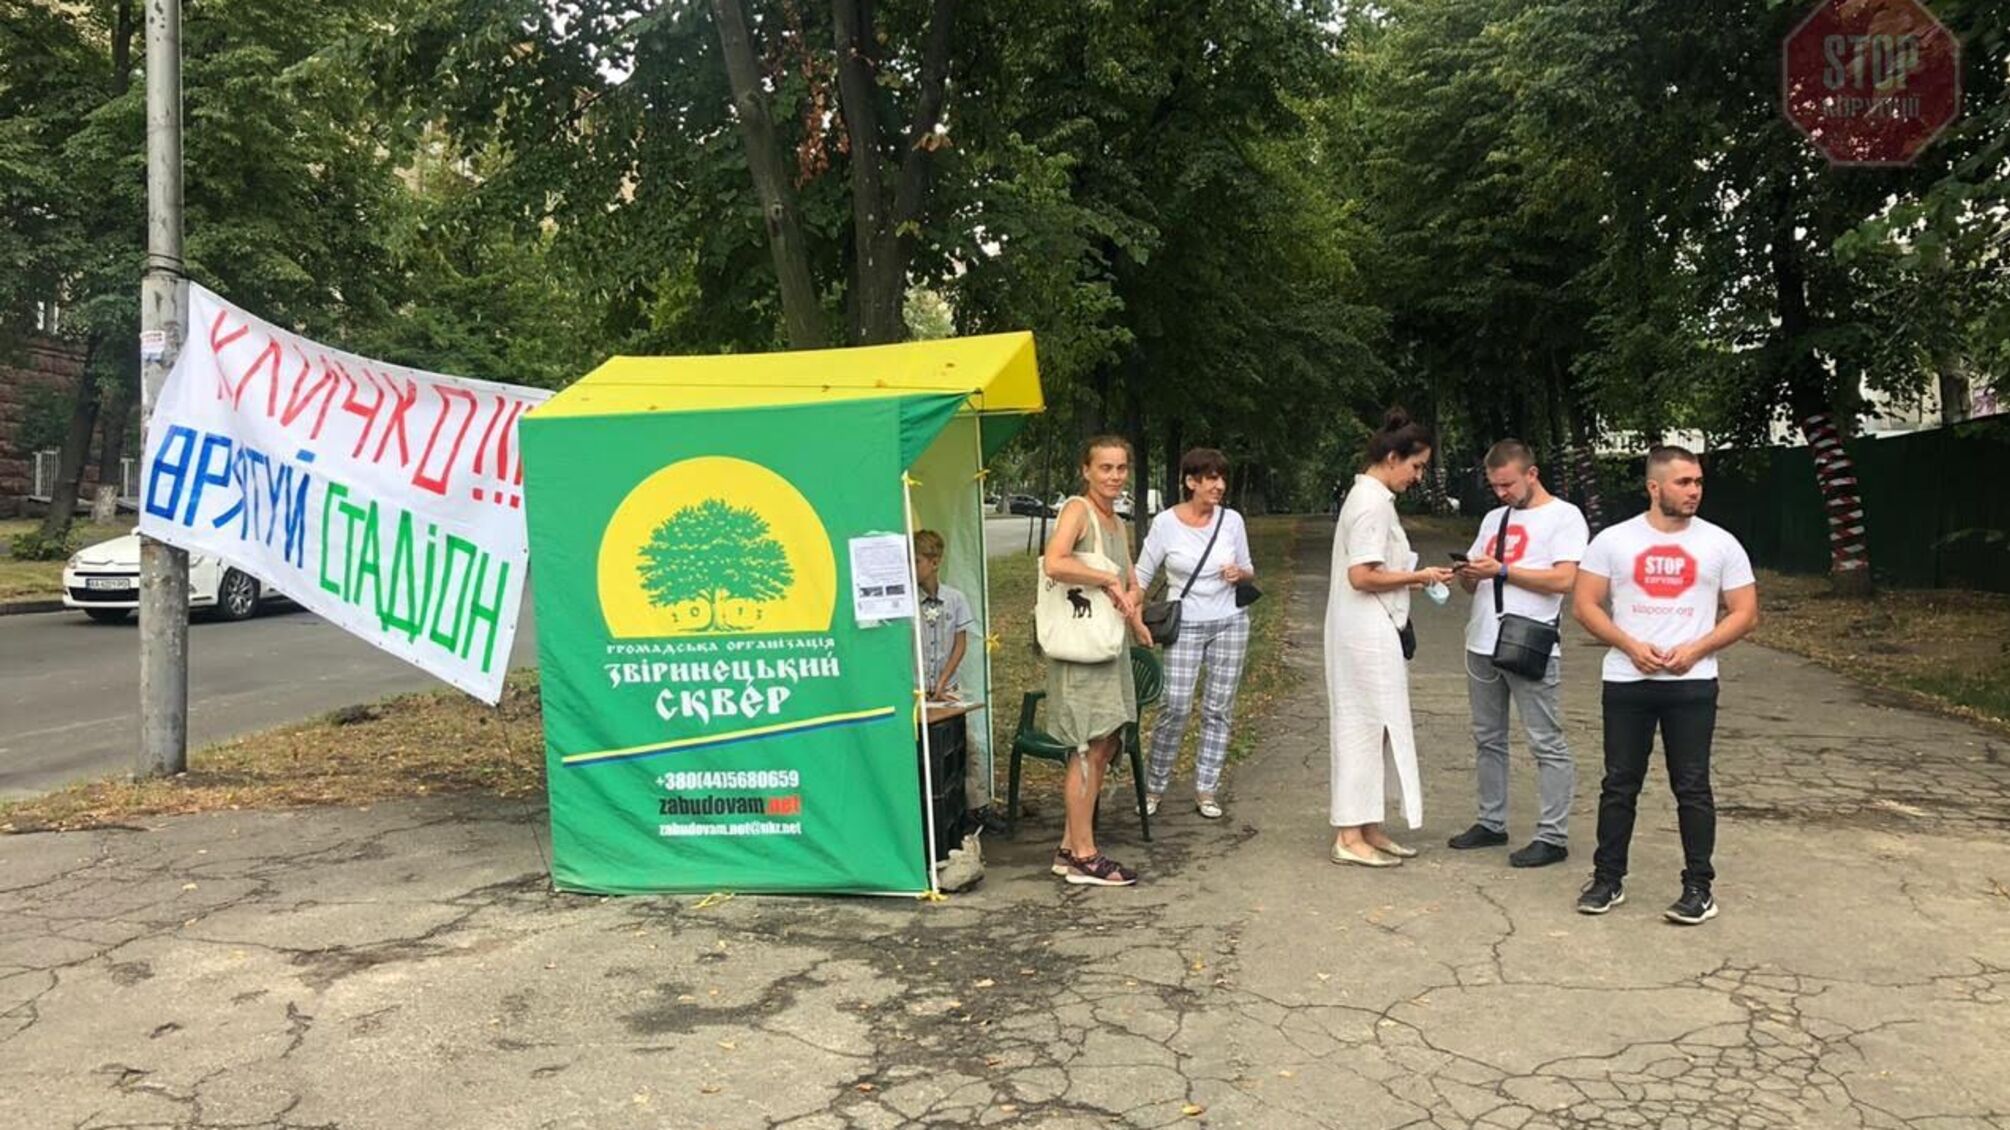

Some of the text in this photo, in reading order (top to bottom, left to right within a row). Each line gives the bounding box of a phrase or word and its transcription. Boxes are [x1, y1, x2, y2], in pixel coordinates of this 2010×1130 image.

[145, 424, 510, 674] ВРЯТУЙ СТАДІОН
[1644, 555, 1686, 576] STOP
[655, 769, 800, 791] +380(44)5680659
[659, 795, 801, 816] zabudovam.net
